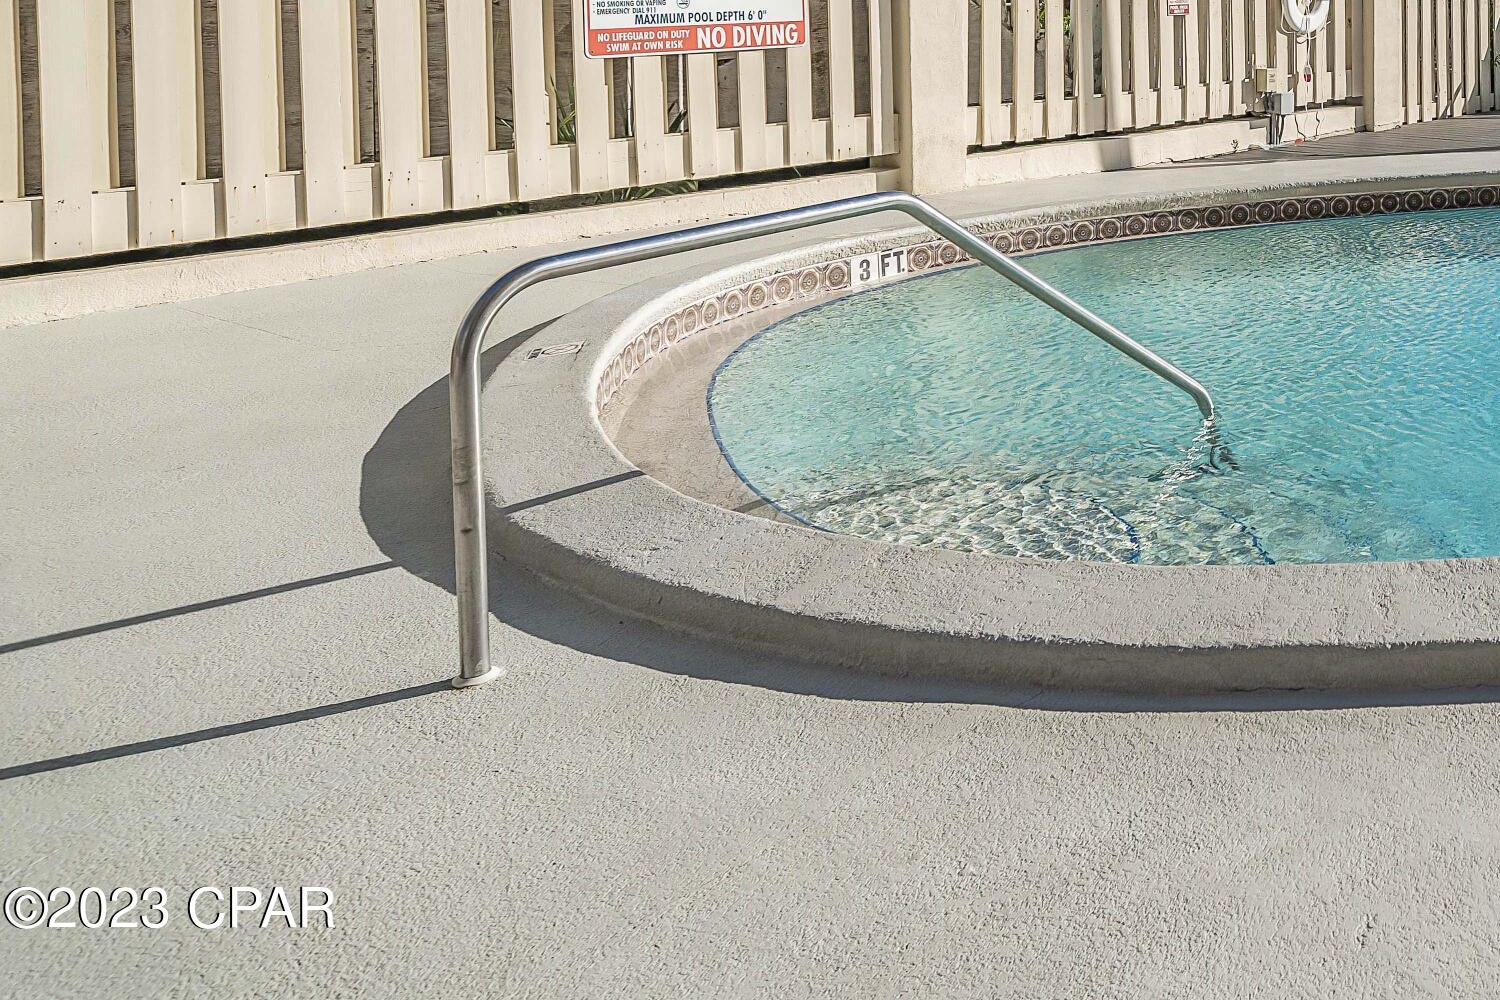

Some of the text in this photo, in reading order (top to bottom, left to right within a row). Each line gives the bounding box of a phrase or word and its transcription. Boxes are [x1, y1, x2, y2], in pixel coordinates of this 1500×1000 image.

[635, 13, 685, 24] MAXIMUM
[688, 12, 714, 22] POOL
[716, 11, 745, 21] DEPTH
[597, 29, 690, 42] NO LIFEGUARD ON DUTY
[696, 23, 799, 49] NO DIVING
[606, 40, 684, 52] SWIM AT OWN RISK
[859, 259, 871, 282] 3
